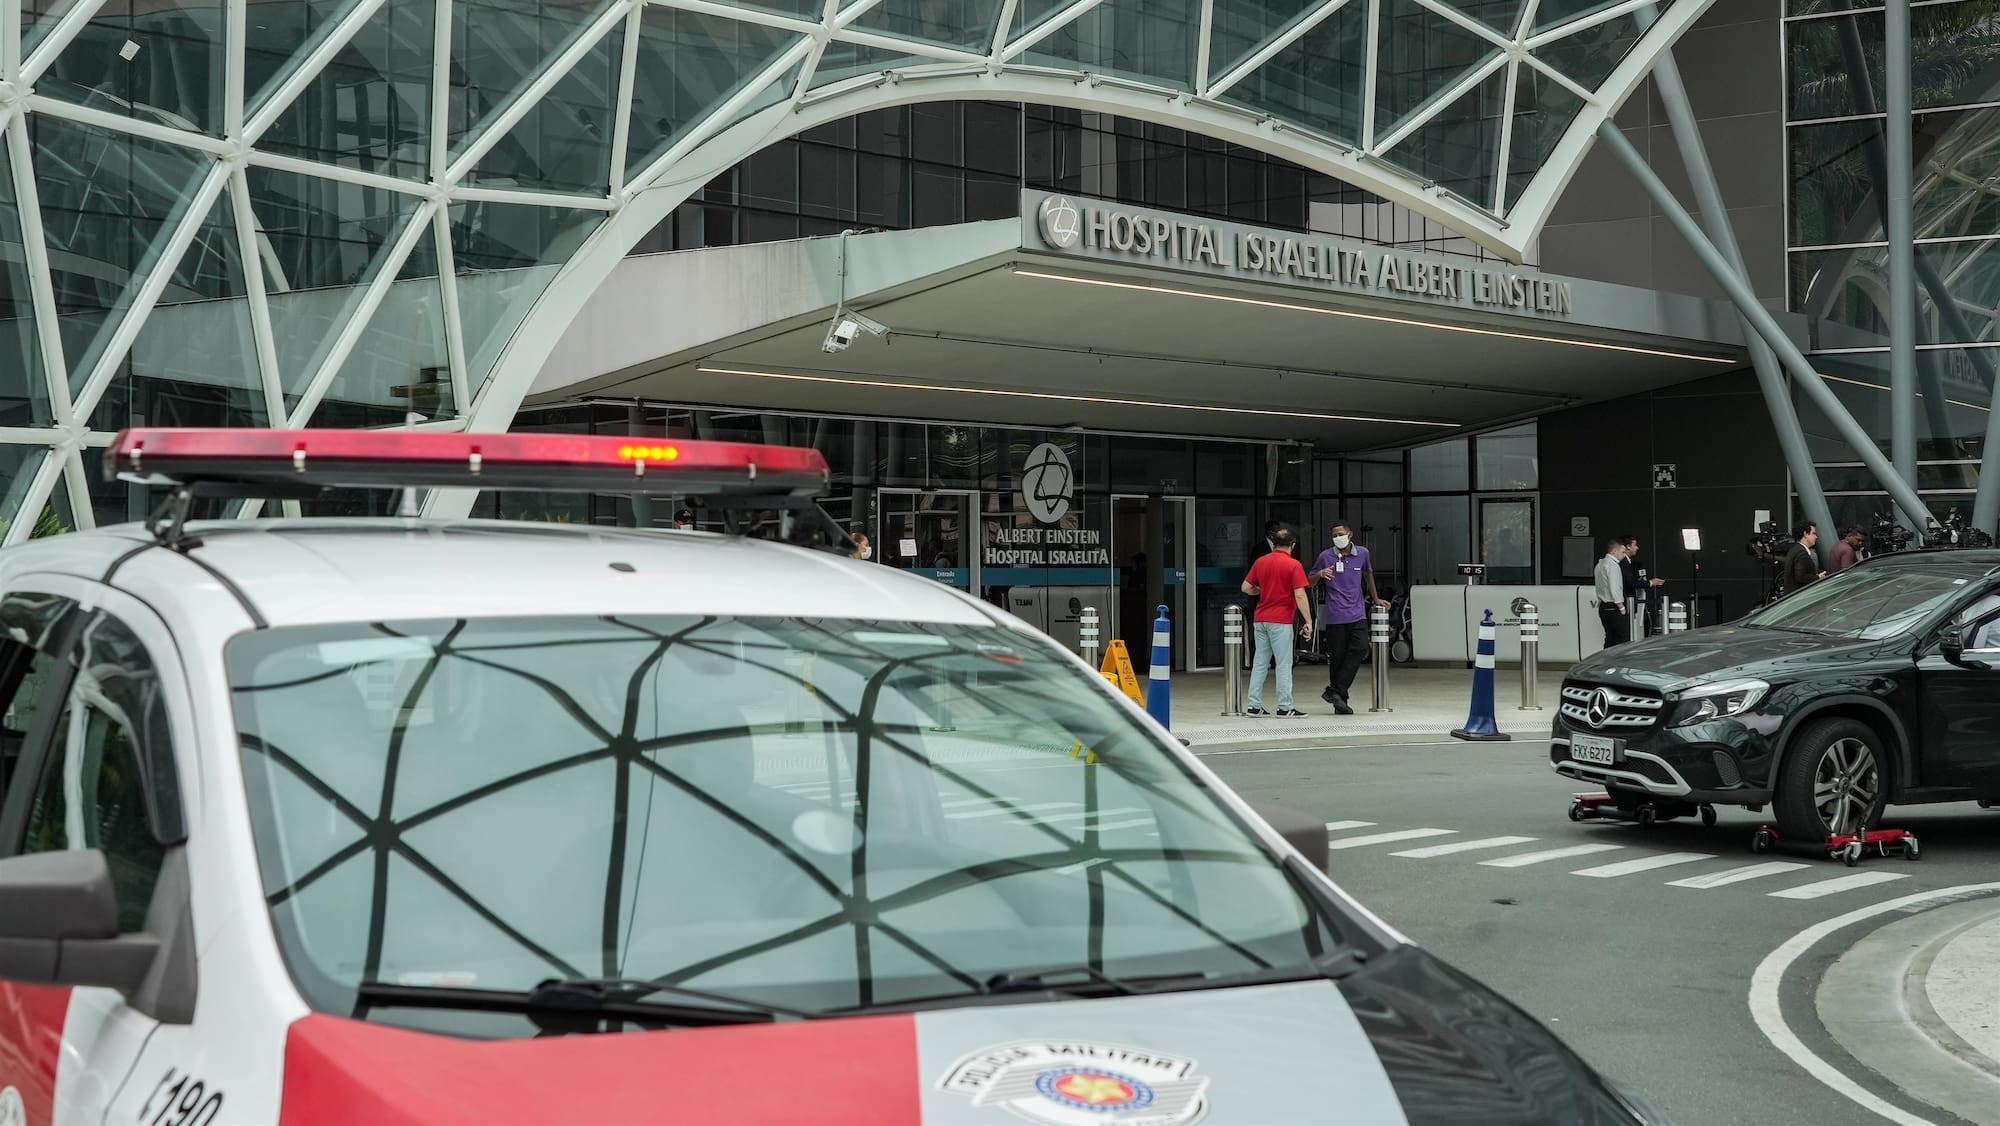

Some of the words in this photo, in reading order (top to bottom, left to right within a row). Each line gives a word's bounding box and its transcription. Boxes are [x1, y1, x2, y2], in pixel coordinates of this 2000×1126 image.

[1085, 207, 1232, 266] HOSPITAL
[1238, 232, 1371, 287] ISRAELITA
[1378, 254, 1470, 300] ALBERT
[1473, 269, 1571, 314] EINSTEIN
[996, 528, 1043, 543] ALBERT
[1046, 529, 1099, 544] EINSTEIN
[985, 548, 1046, 564] HOSPITAL
[1048, 548, 1109, 564] ISRAELITA
